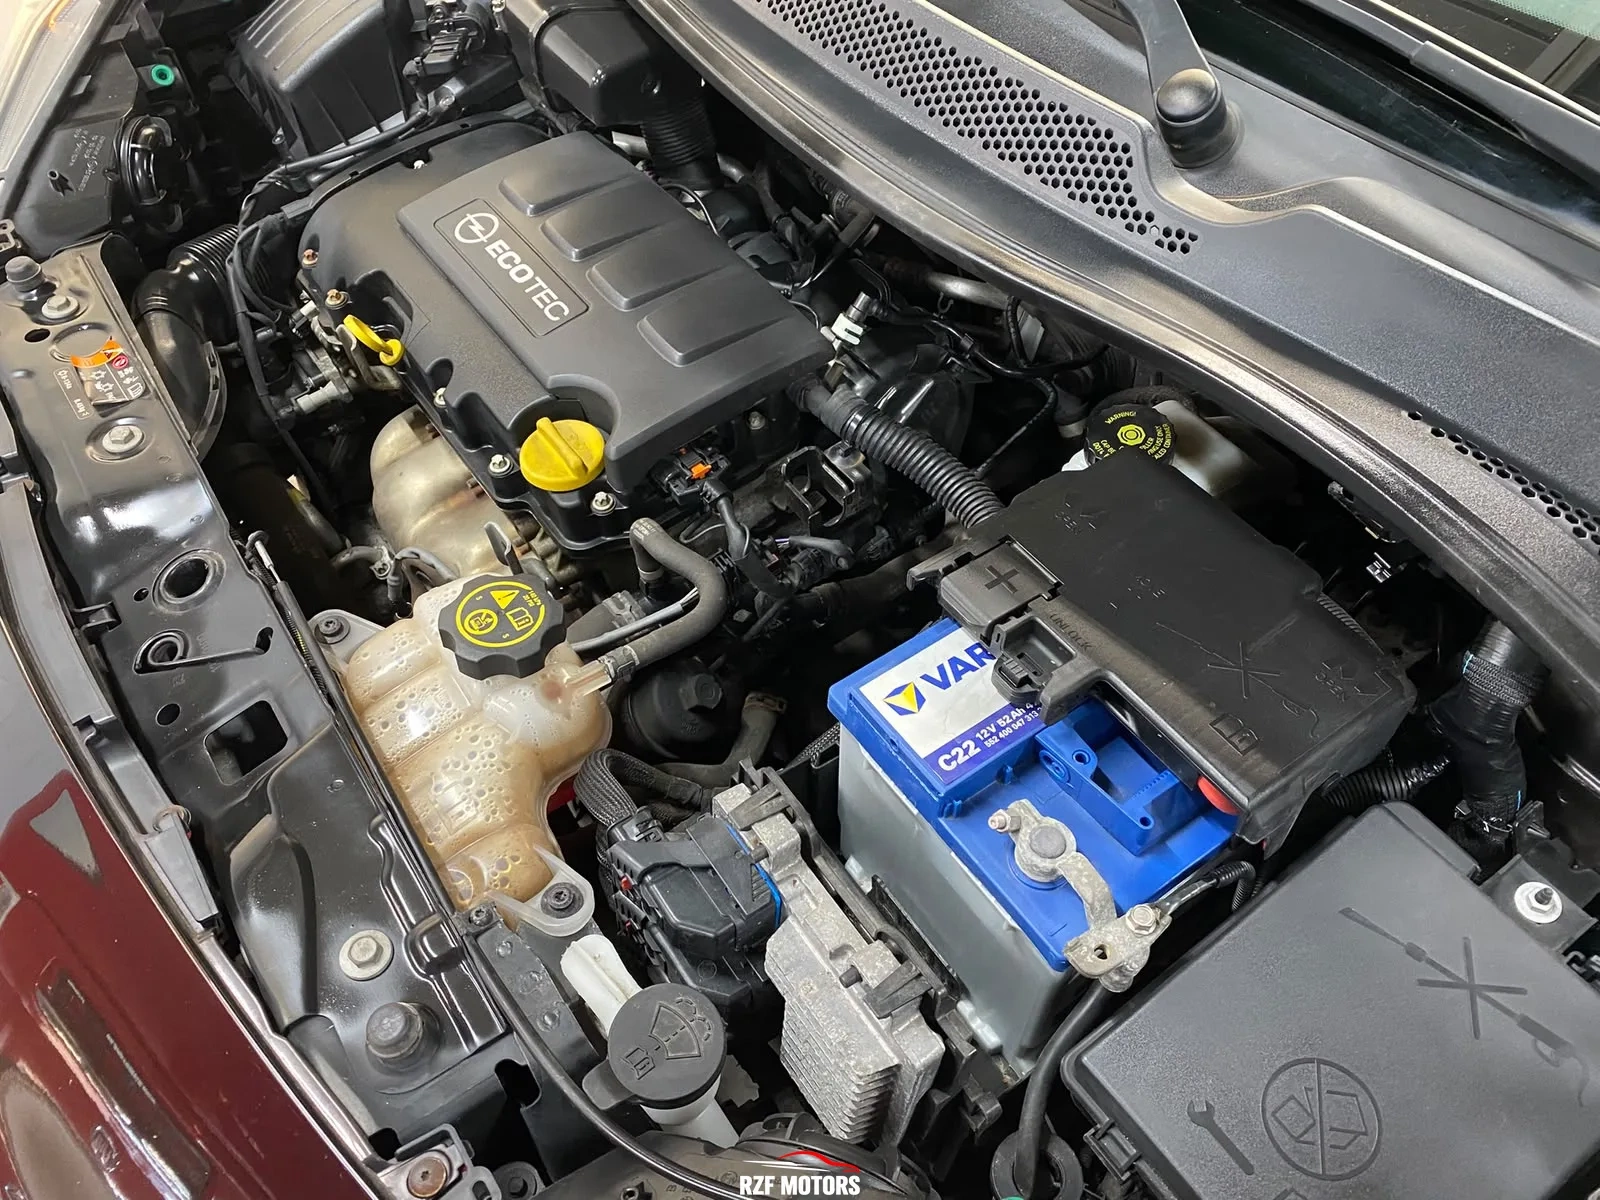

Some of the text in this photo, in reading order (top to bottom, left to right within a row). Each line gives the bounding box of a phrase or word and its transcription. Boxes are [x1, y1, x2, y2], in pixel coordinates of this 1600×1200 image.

[484, 239, 570, 321] ECOTEC
[1049, 613, 1094, 651] UNLOCK
[919, 642, 997, 691] VAR
[975, 707, 1027, 741] 12V 52Ah
[983, 710, 1039, 748] 552 400 047 313
[937, 739, 981, 772] C22
